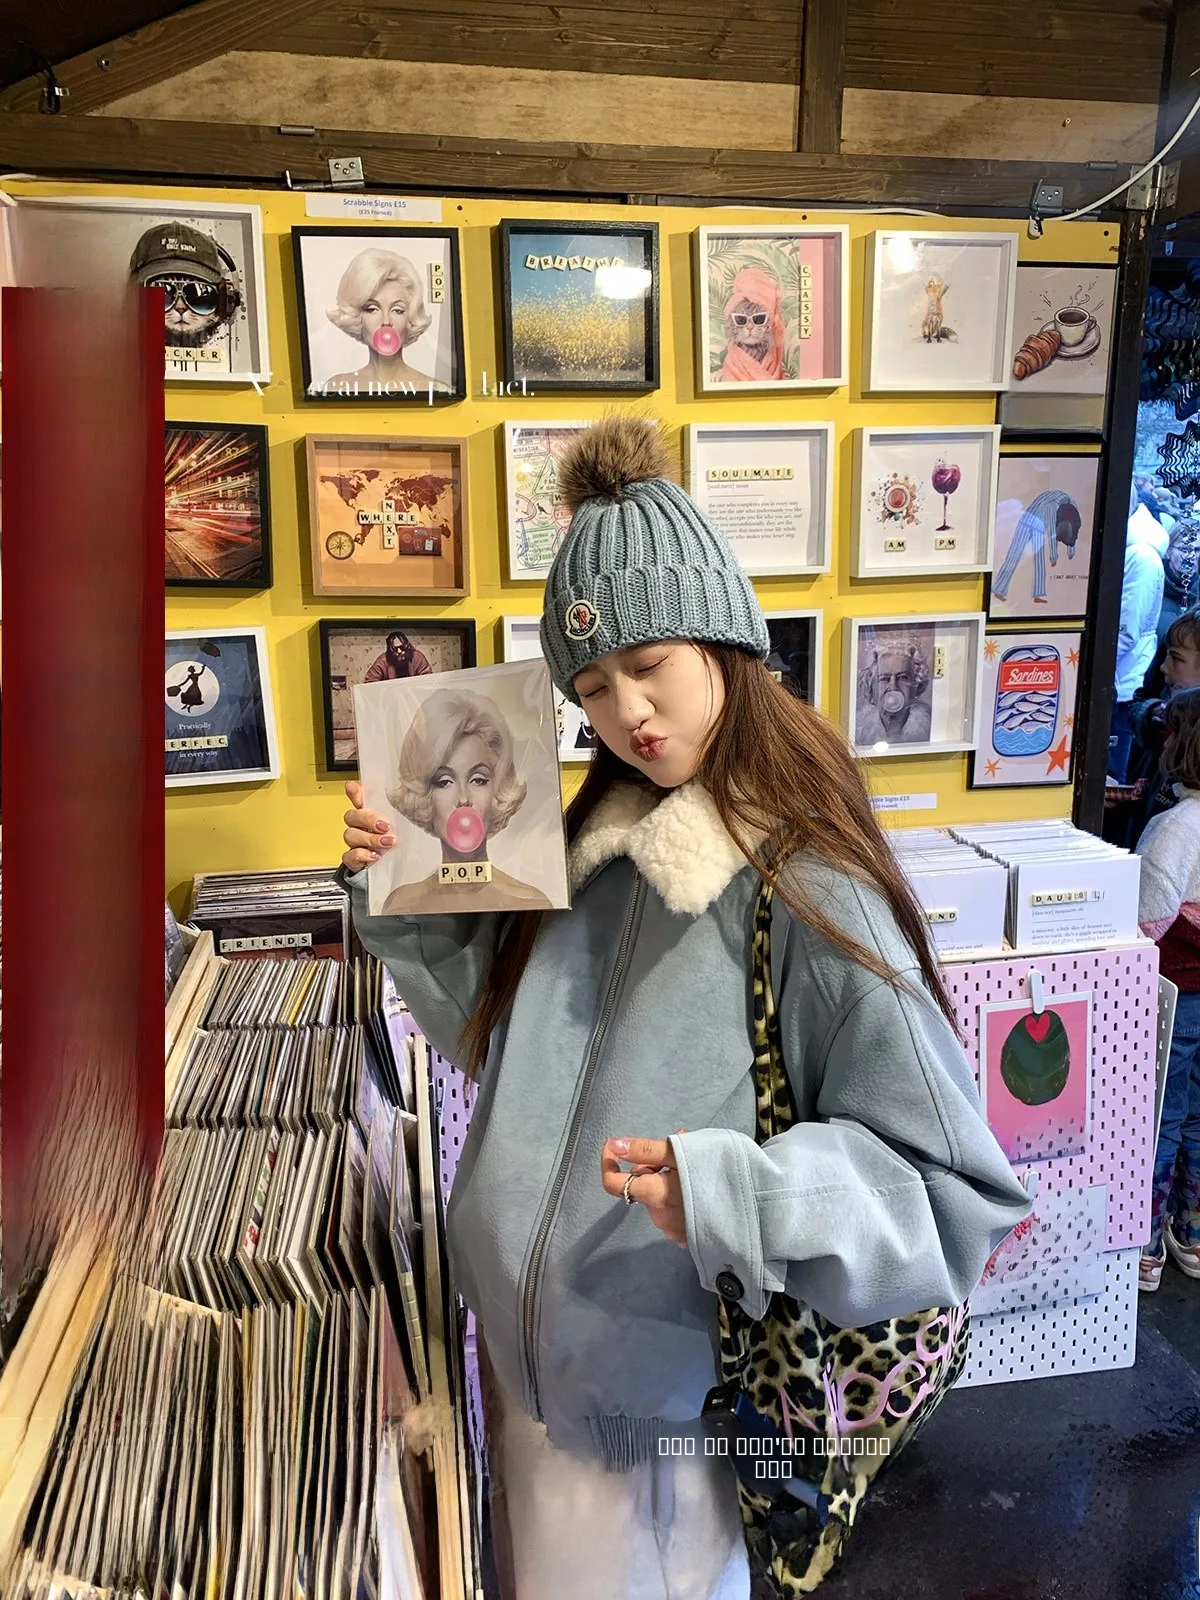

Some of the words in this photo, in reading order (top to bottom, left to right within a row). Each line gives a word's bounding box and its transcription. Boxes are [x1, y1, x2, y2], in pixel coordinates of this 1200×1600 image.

[343, 199, 373, 207] Scrabble
[374, 200, 393, 208] Signs
[433, 264, 443, 300] POP
[802, 266, 811, 336] CLASSY
[168, 349, 219, 360] CKER
[711, 470, 792, 478] SOULMATE
[360, 514, 415, 522] WHERE
[385, 502, 394, 546] NEXT
[940, 539, 954, 547] PM
[1009, 666, 1054, 683] Sardines
[179, 722, 212, 730] Practically
[170, 738, 226, 748] ERFEC
[442, 866, 484, 880] POP
[928, 912, 956, 920] END
[222, 936, 307, 950] FRIENDS
